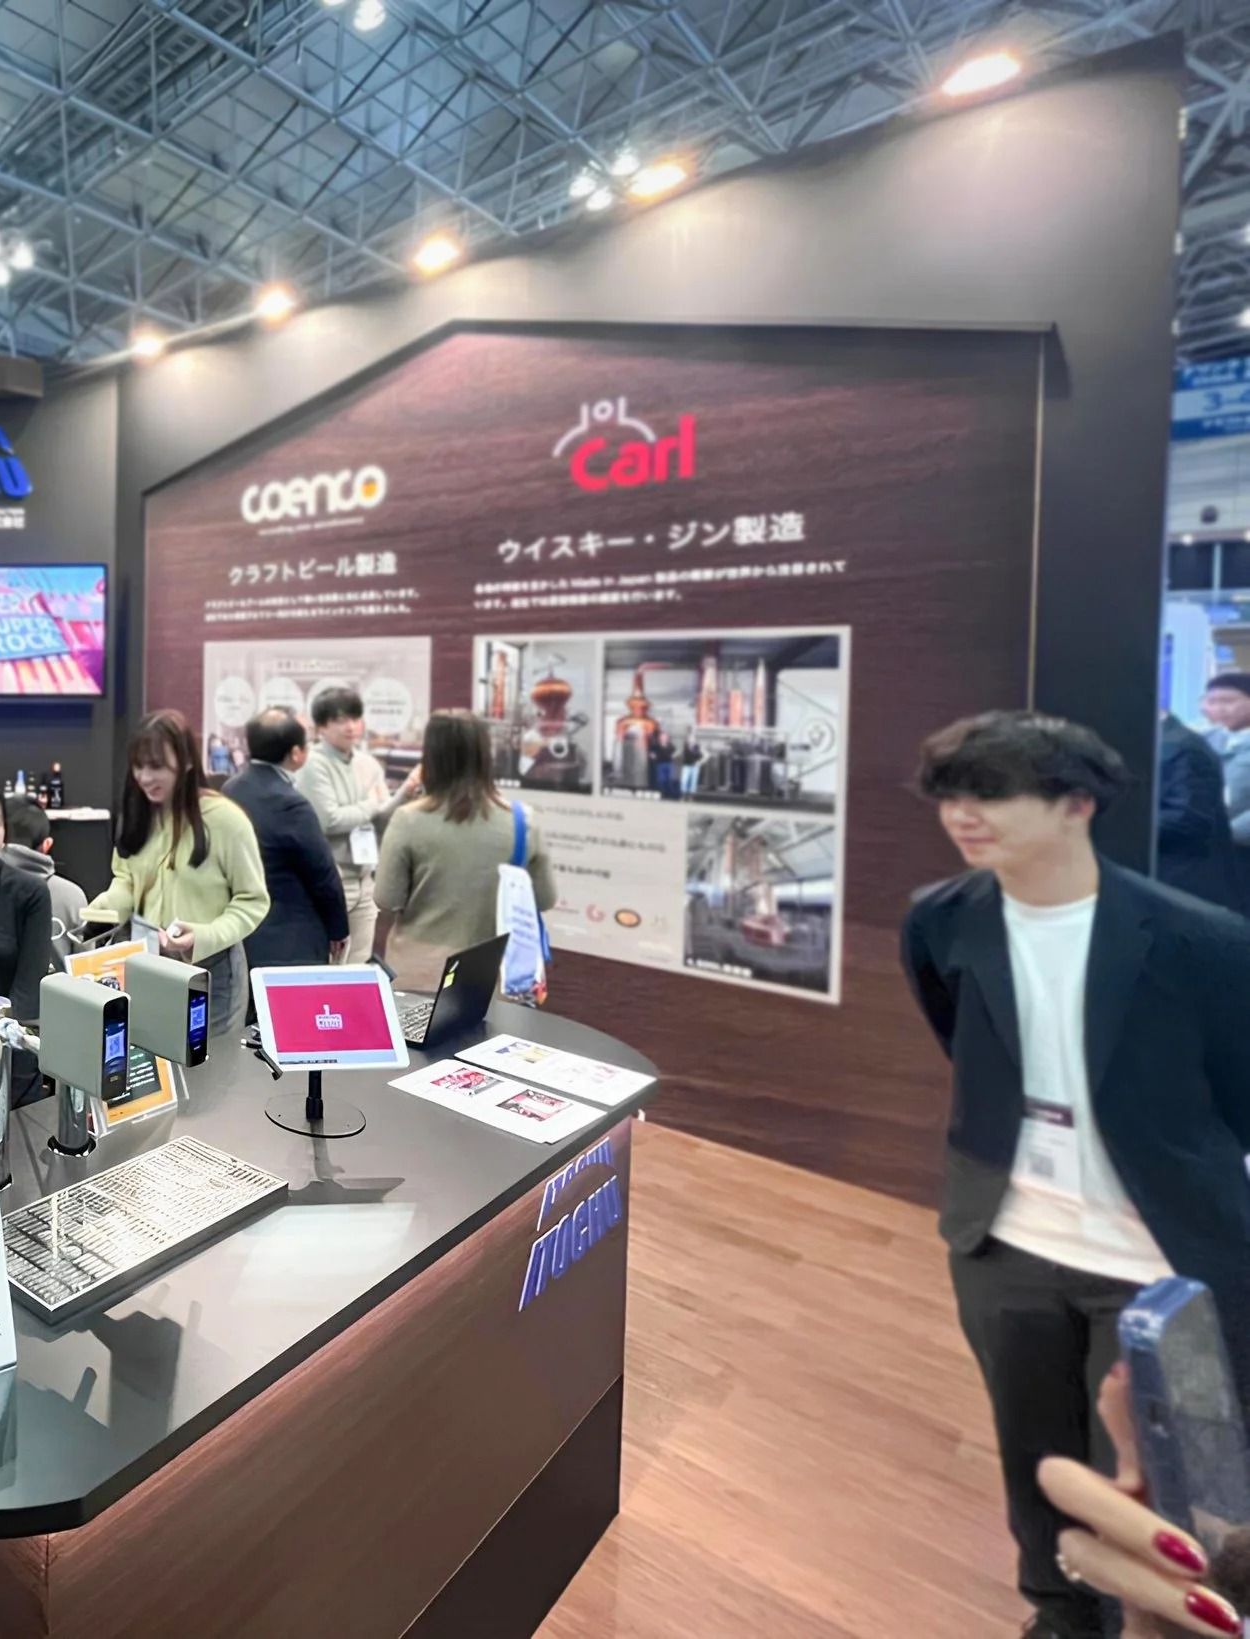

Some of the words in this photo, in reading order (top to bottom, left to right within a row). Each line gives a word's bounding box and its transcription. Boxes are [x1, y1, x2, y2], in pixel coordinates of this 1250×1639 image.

[497, 512, 805, 563] ウイスキー・ジン製造
[229, 551, 398, 586] クラフトビール製造
[519, 1174, 623, 1312] ITOCHU
